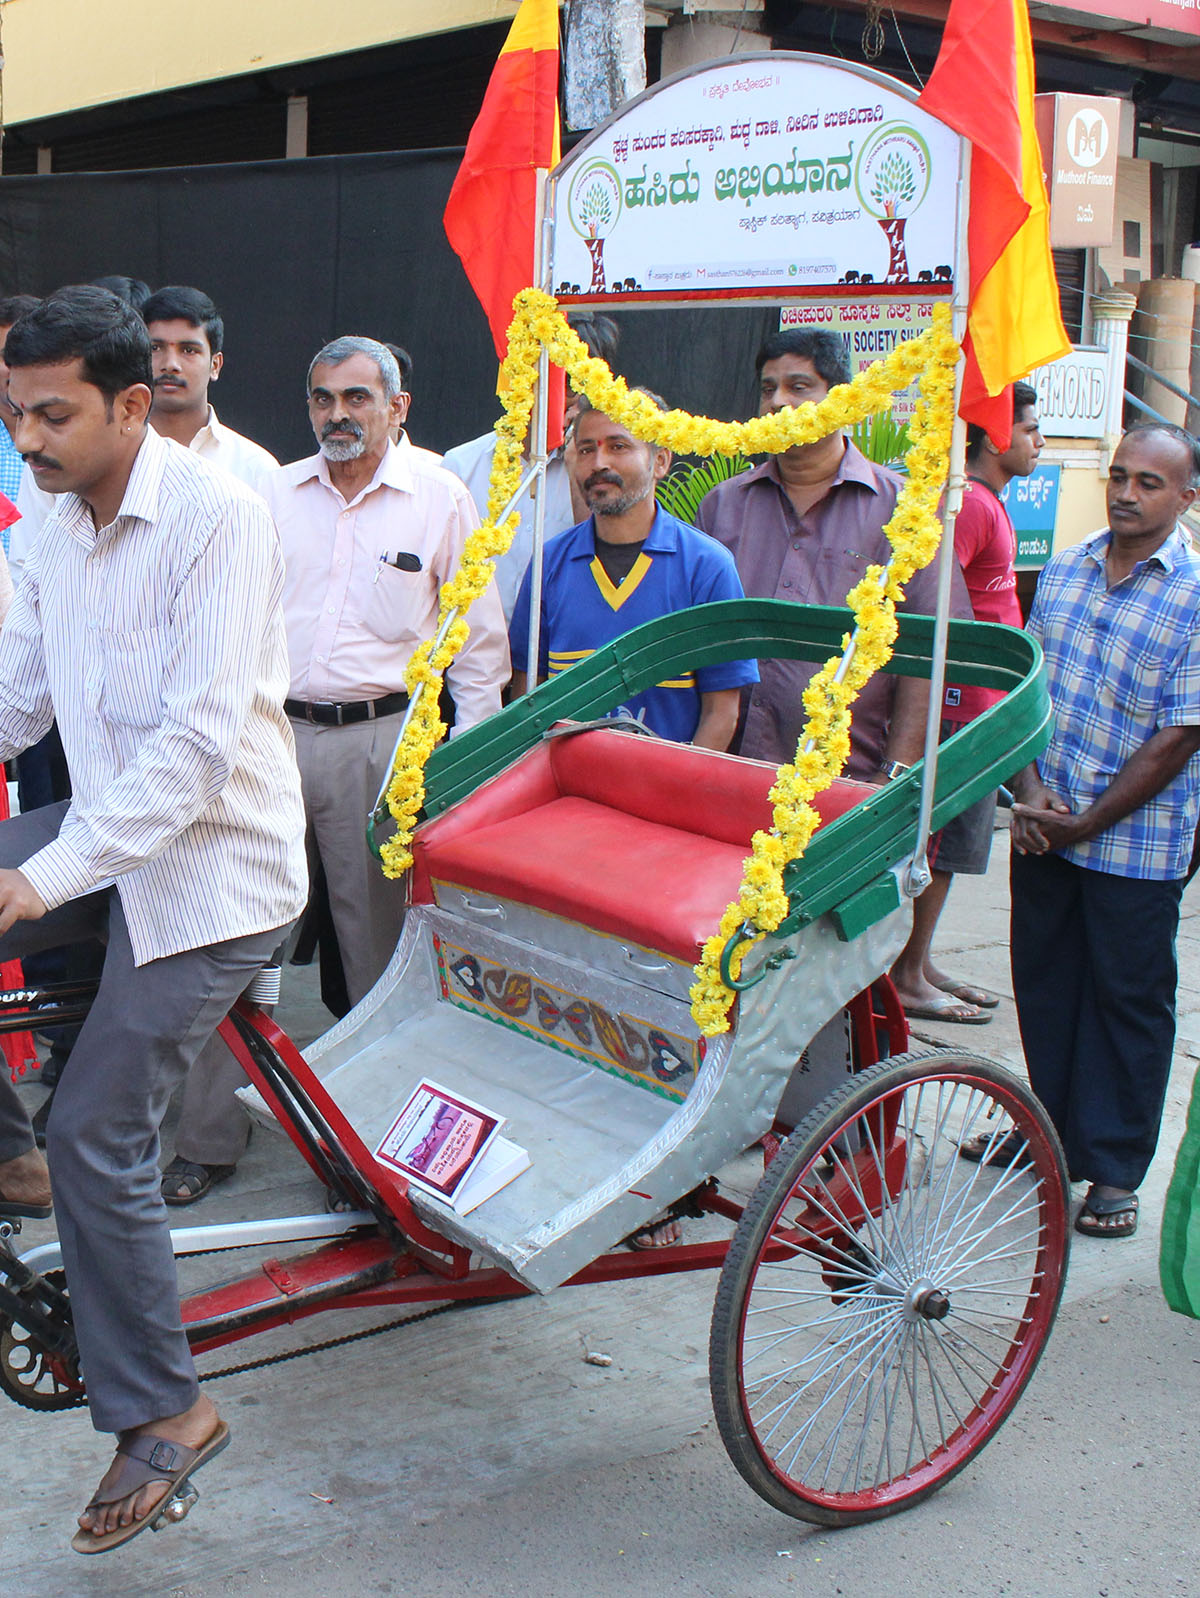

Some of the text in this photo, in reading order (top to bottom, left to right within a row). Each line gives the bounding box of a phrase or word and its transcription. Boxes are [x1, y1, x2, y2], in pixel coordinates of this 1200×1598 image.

[633, 130, 666, 152] ಸುಂದರ
[755, 119, 781, 137] ಗಾಳಿ,
[786, 108, 819, 133] ನೀರಿನ
[824, 104, 884, 128] ಉಳಿವಿಗಾಗಿ
[625, 159, 700, 209] ಹಸಿರು
[714, 141, 854, 207] ಅಭಿಯಾನ
[1057, 169, 1086, 185] Muthoot
[1087, 171, 1113, 186] Finance
[854, 329, 897, 352] SOCIETY
[1028, 364, 1105, 419] AMOND
[1018, 539, 1048, 555] ಉಡುಪಿ
